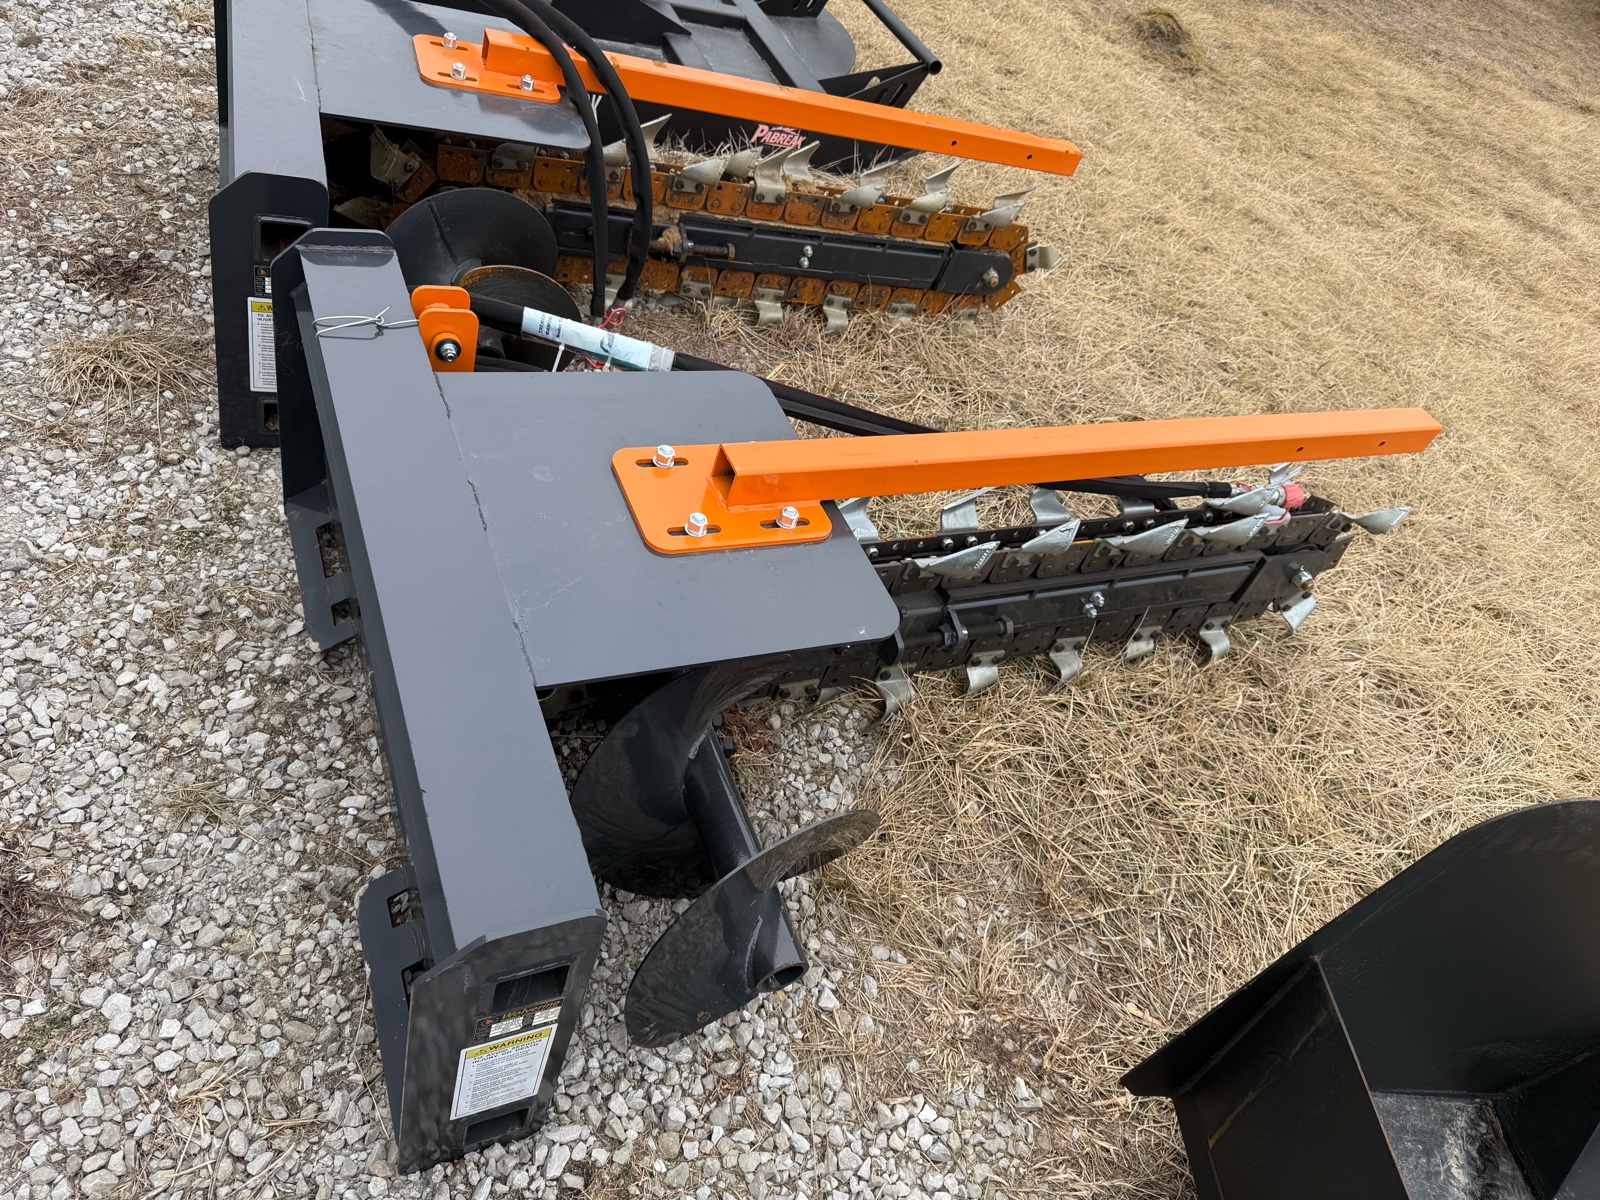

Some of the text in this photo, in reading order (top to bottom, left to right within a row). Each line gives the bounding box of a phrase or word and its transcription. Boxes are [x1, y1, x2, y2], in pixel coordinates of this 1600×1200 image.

[750, 124, 807, 150] PABREAK
[486, 1048, 508, 1058] AVOID
[512, 1039, 543, 1050] SERIOUS
[489, 1033, 543, 1051] WARNING
[472, 1055, 497, 1064] INJURY
[515, 1043, 539, 1052] DEATH
